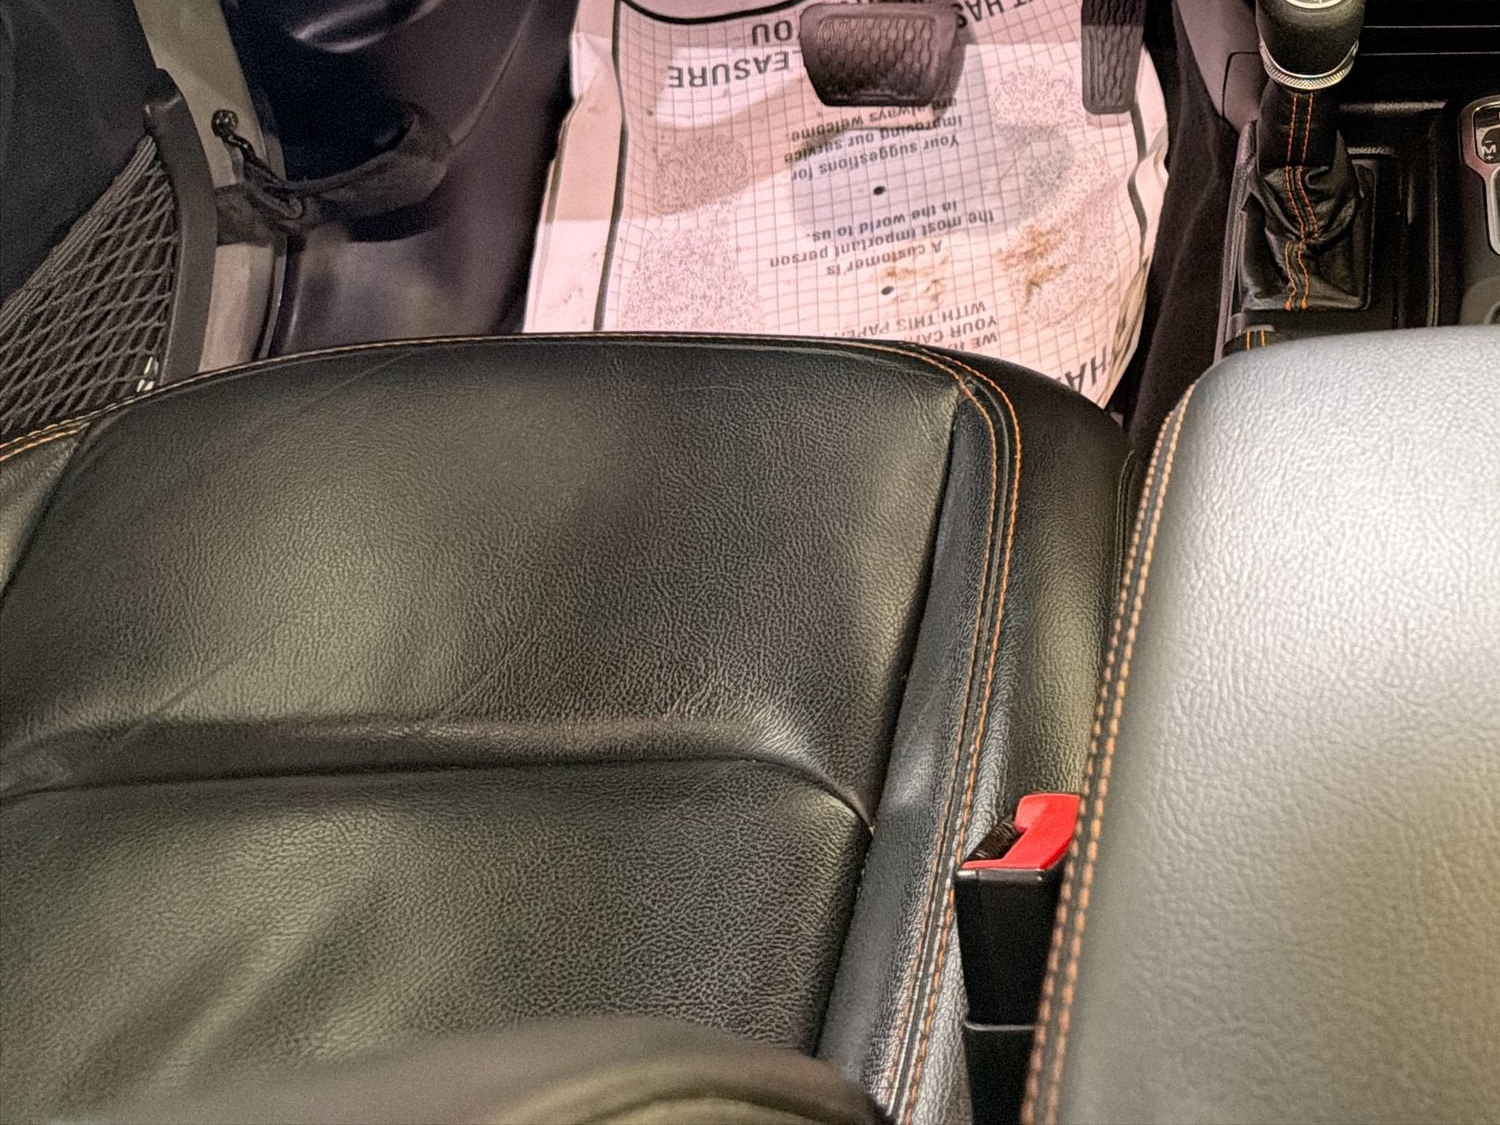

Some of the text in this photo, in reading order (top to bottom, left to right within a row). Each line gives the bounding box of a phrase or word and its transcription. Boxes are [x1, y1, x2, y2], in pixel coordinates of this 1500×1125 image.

[752, 20, 800, 46] OU
[848, 134, 875, 148] our
[790, 134, 961, 183] Your suggestions for
[911, 205, 937, 220] the
[941, 200, 958, 213] in
[836, 225, 854, 237] to
[859, 214, 907, 235] world
[769, 209, 995, 268] the most important person
[826, 239, 943, 277] A customer is
[896, 313, 936, 330] THIS
[942, 301, 987, 323] WITH
[949, 314, 998, 339] YOUR
[970, 331, 998, 349] WE
